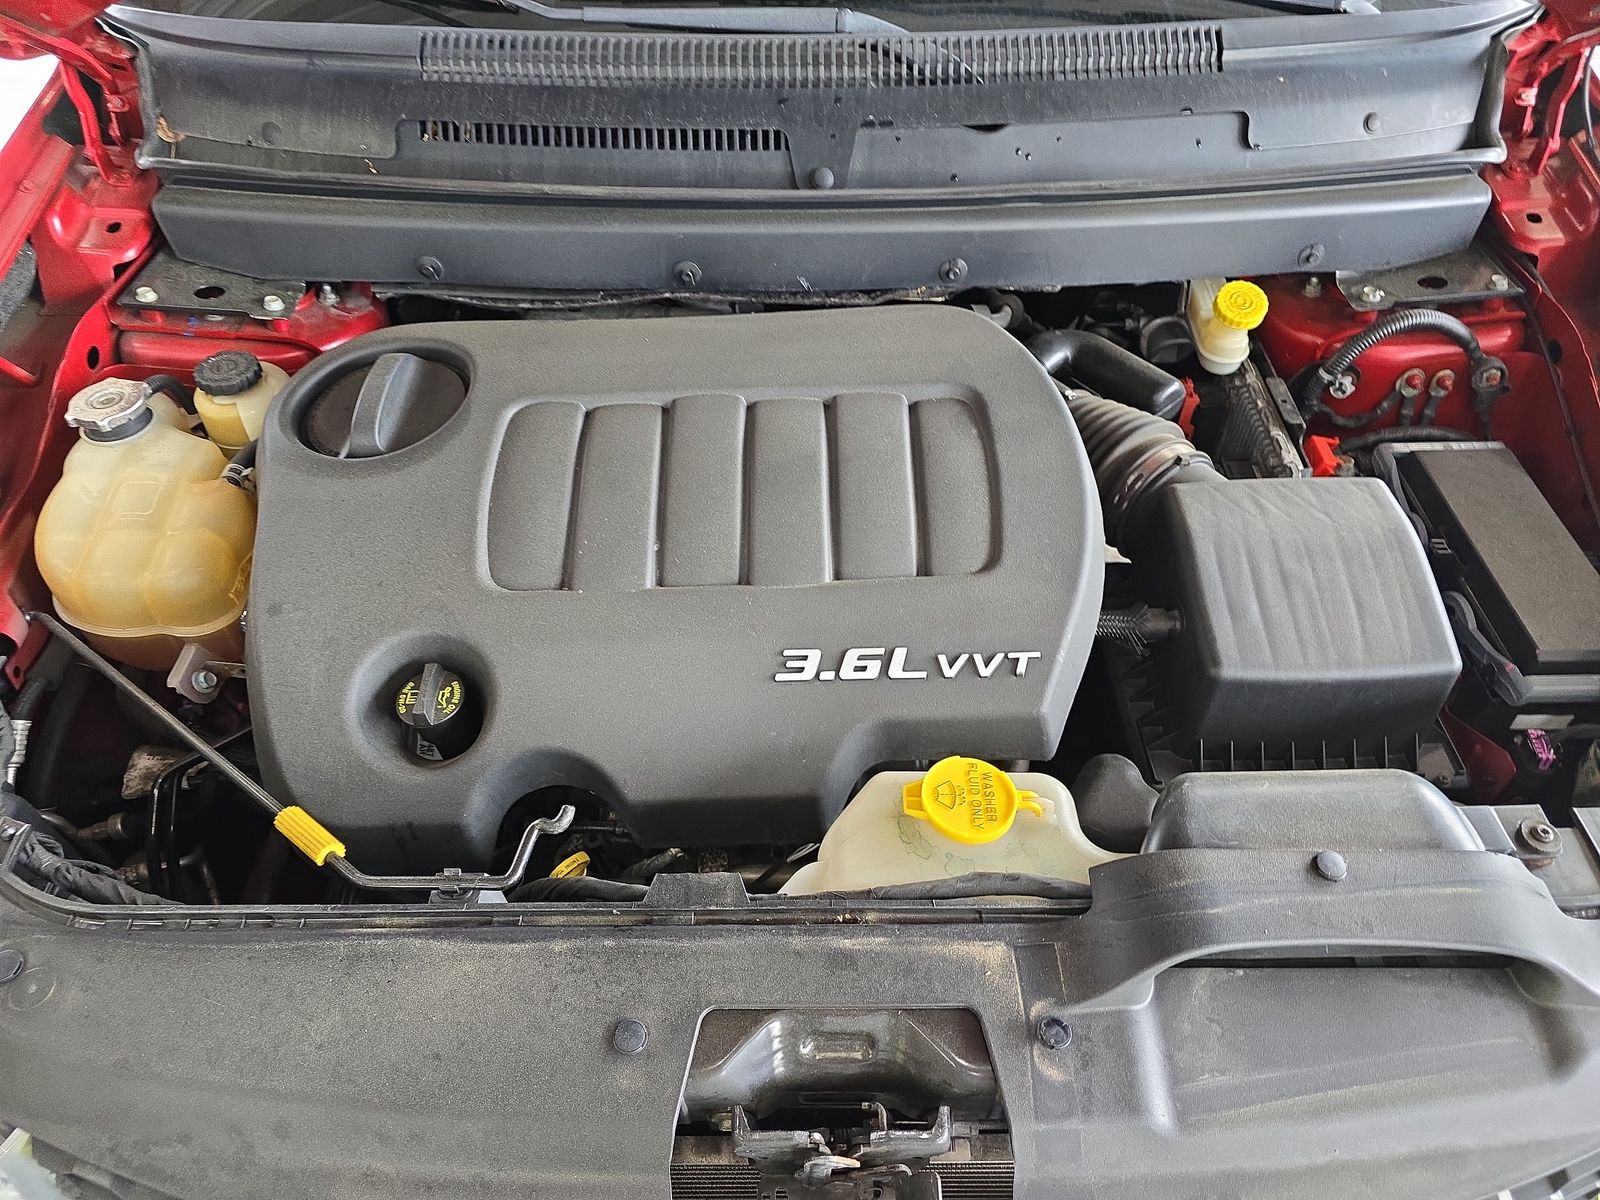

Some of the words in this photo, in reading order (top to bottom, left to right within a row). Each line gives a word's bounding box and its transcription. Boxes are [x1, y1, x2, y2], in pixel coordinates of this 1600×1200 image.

[774, 647, 928, 682] 3.6L
[936, 651, 1042, 679] VVT
[451, 681, 461, 704] ENGINE
[443, 704, 456, 714] OIL
[966, 763, 980, 796] FLUID
[982, 771, 998, 823] WASHER
[970, 799, 985, 830] ONLY
